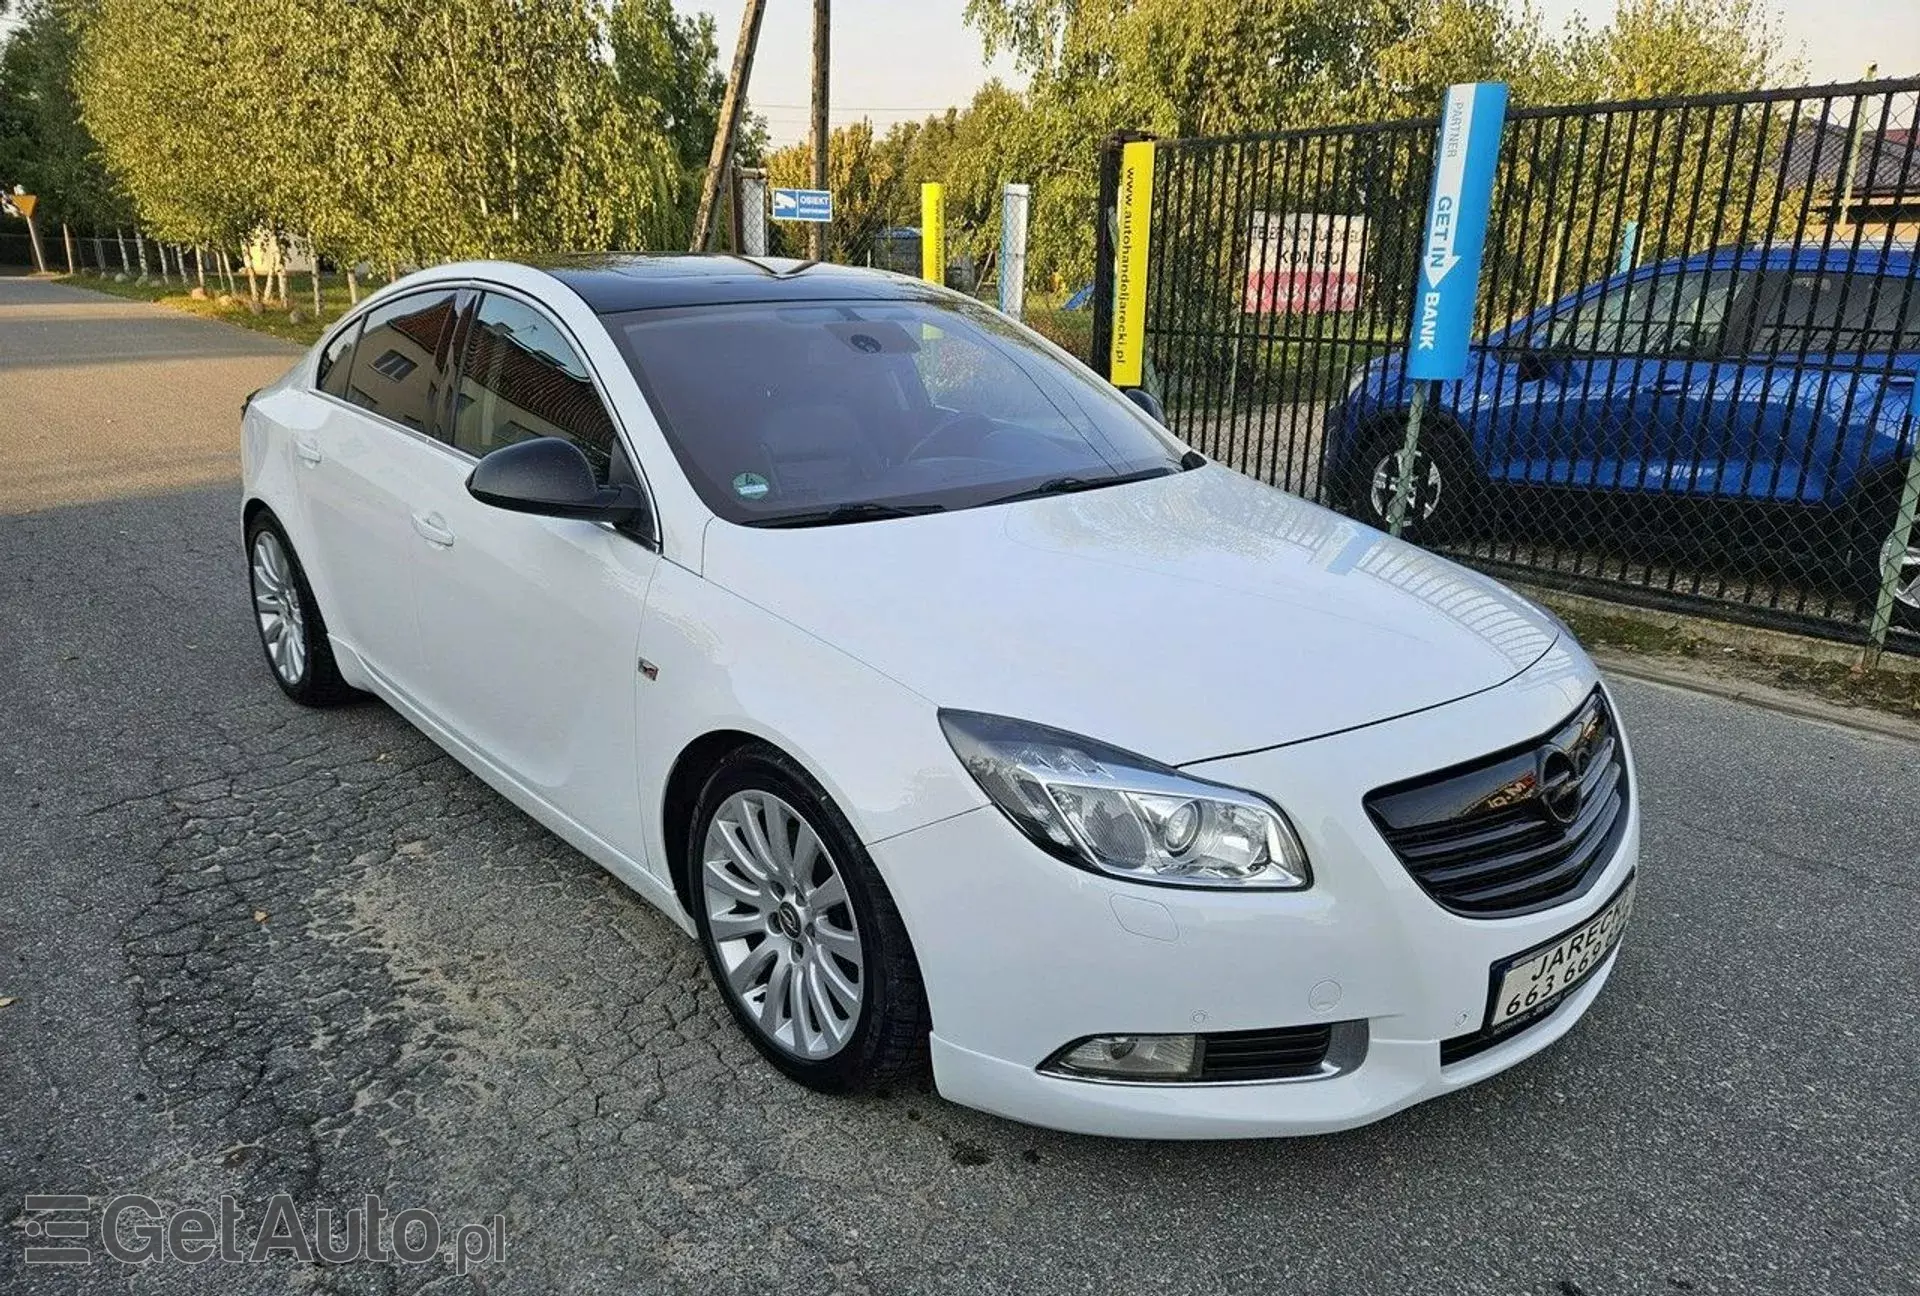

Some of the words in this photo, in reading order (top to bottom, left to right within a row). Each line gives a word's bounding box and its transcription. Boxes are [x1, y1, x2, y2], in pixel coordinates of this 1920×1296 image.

[1447, 102, 1464, 158] PARTNER
[1418, 292, 1441, 350] BANK
[1506, 974, 1555, 1017] 663
